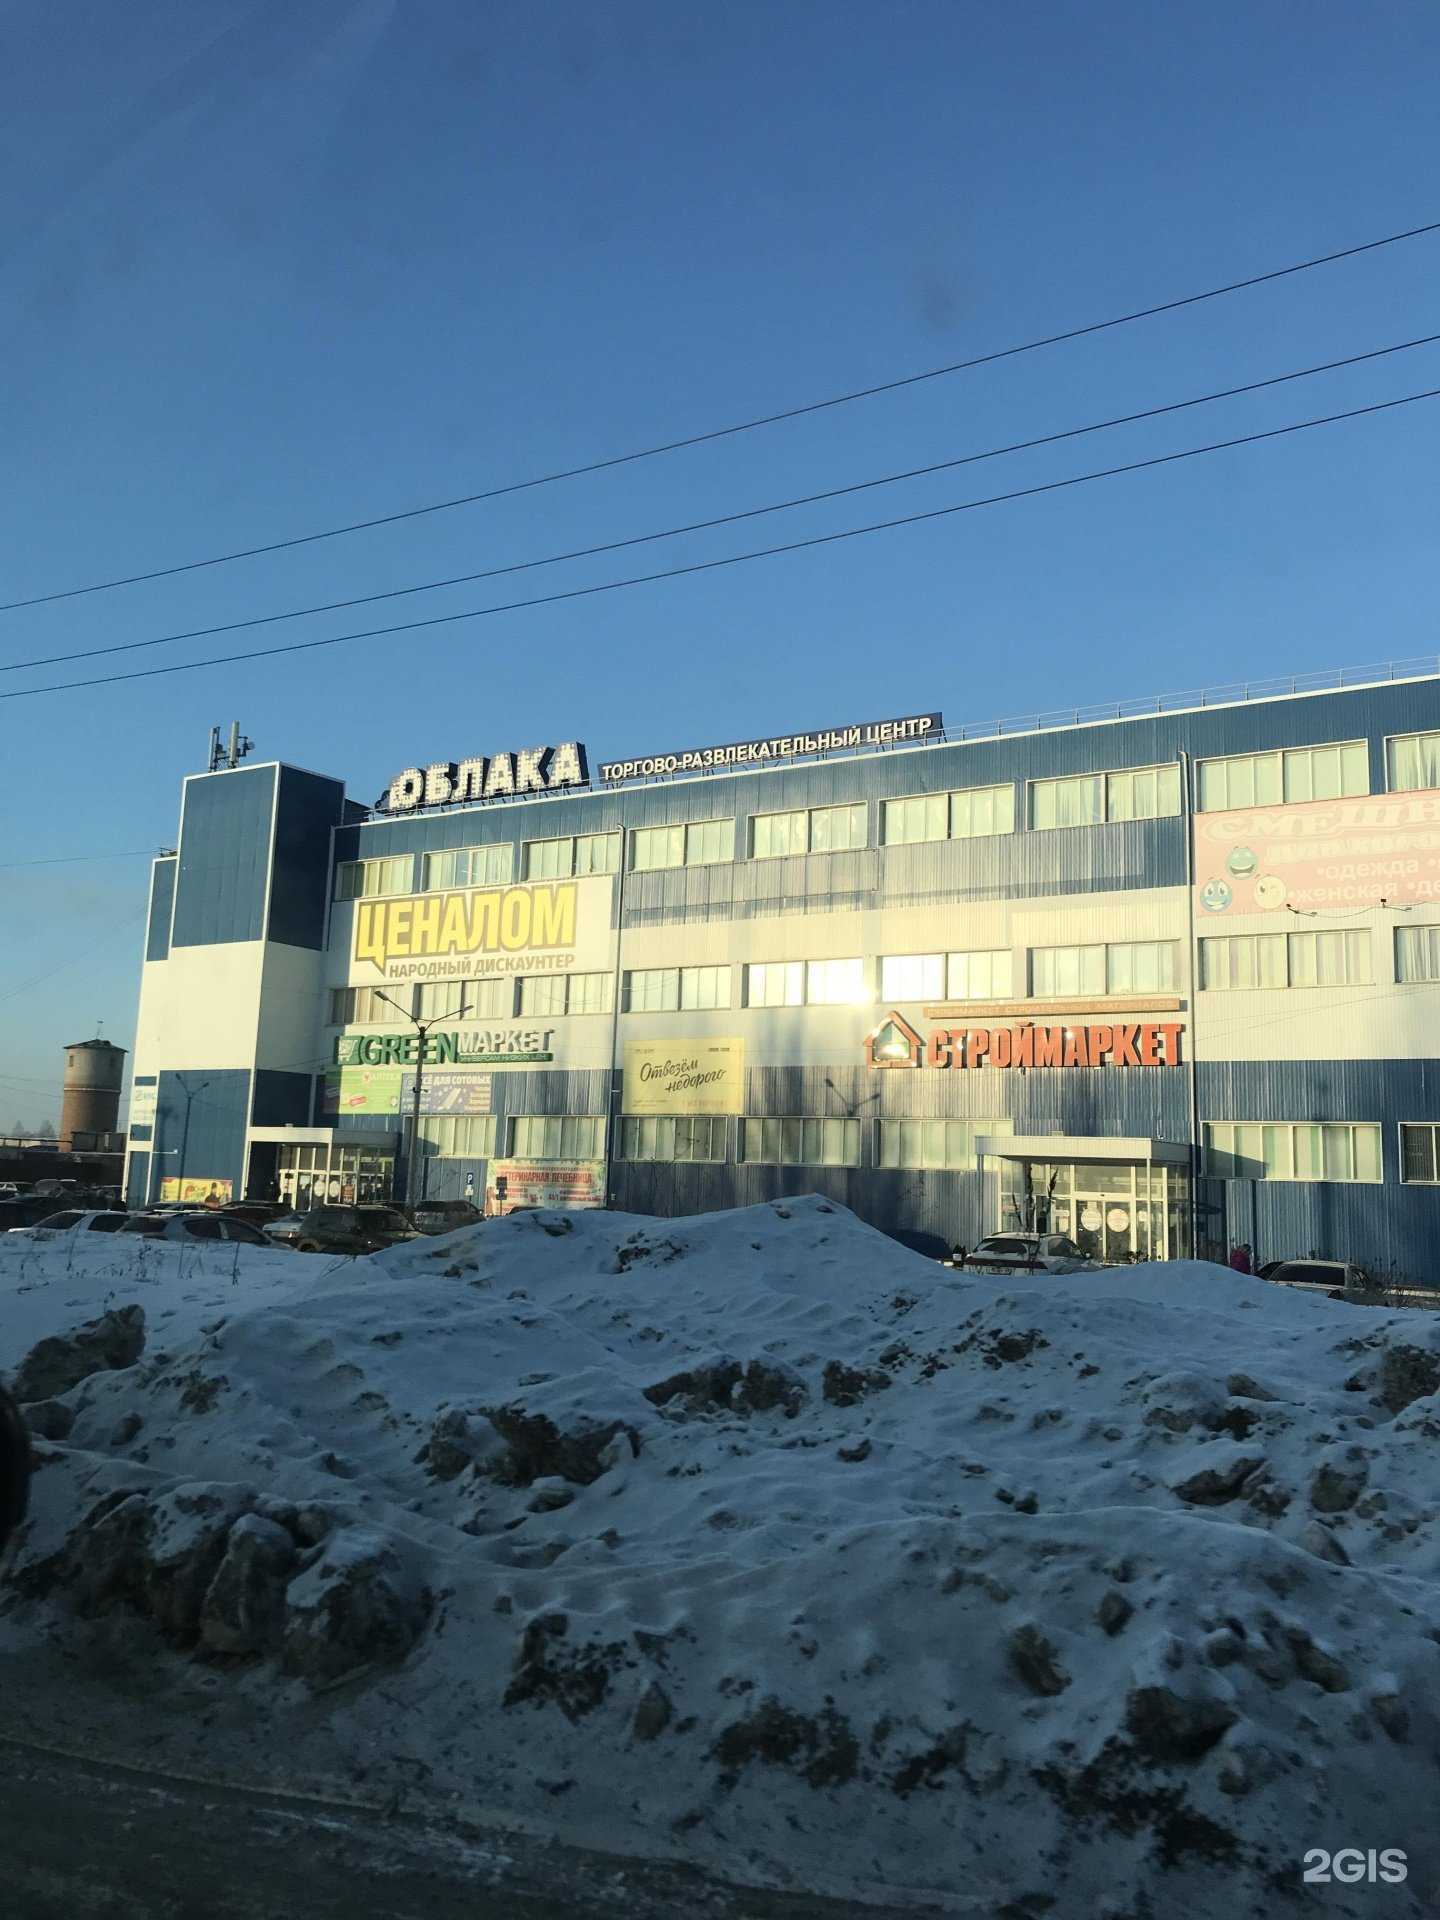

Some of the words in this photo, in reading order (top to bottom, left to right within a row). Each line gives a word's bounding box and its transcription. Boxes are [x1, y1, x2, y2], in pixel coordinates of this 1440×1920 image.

[602, 724, 862, 781] ТОРГОВО-РАЗВЛЕКАТЕЛЬНЫЙ
[866, 716, 933, 745] ЦЕНТР
[386, 741, 588, 810] ОБЛАКА
[1295, 881, 1398, 903] женская
[357, 886, 576, 971] ЦЕНАЛОМ
[389, 955, 471, 978] НАРОДНЫЙ
[474, 952, 576, 976] ДИСКАУНТЕР
[361, 1034, 457, 1064] GREEN
[458, 1029, 555, 1053] МАРКЕТ
[927, 1020, 1185, 1069] СТРОЙМАРКЕТ
[640, 1058, 698, 1082] Отвезём
[664, 1069, 727, 1093] недорого
